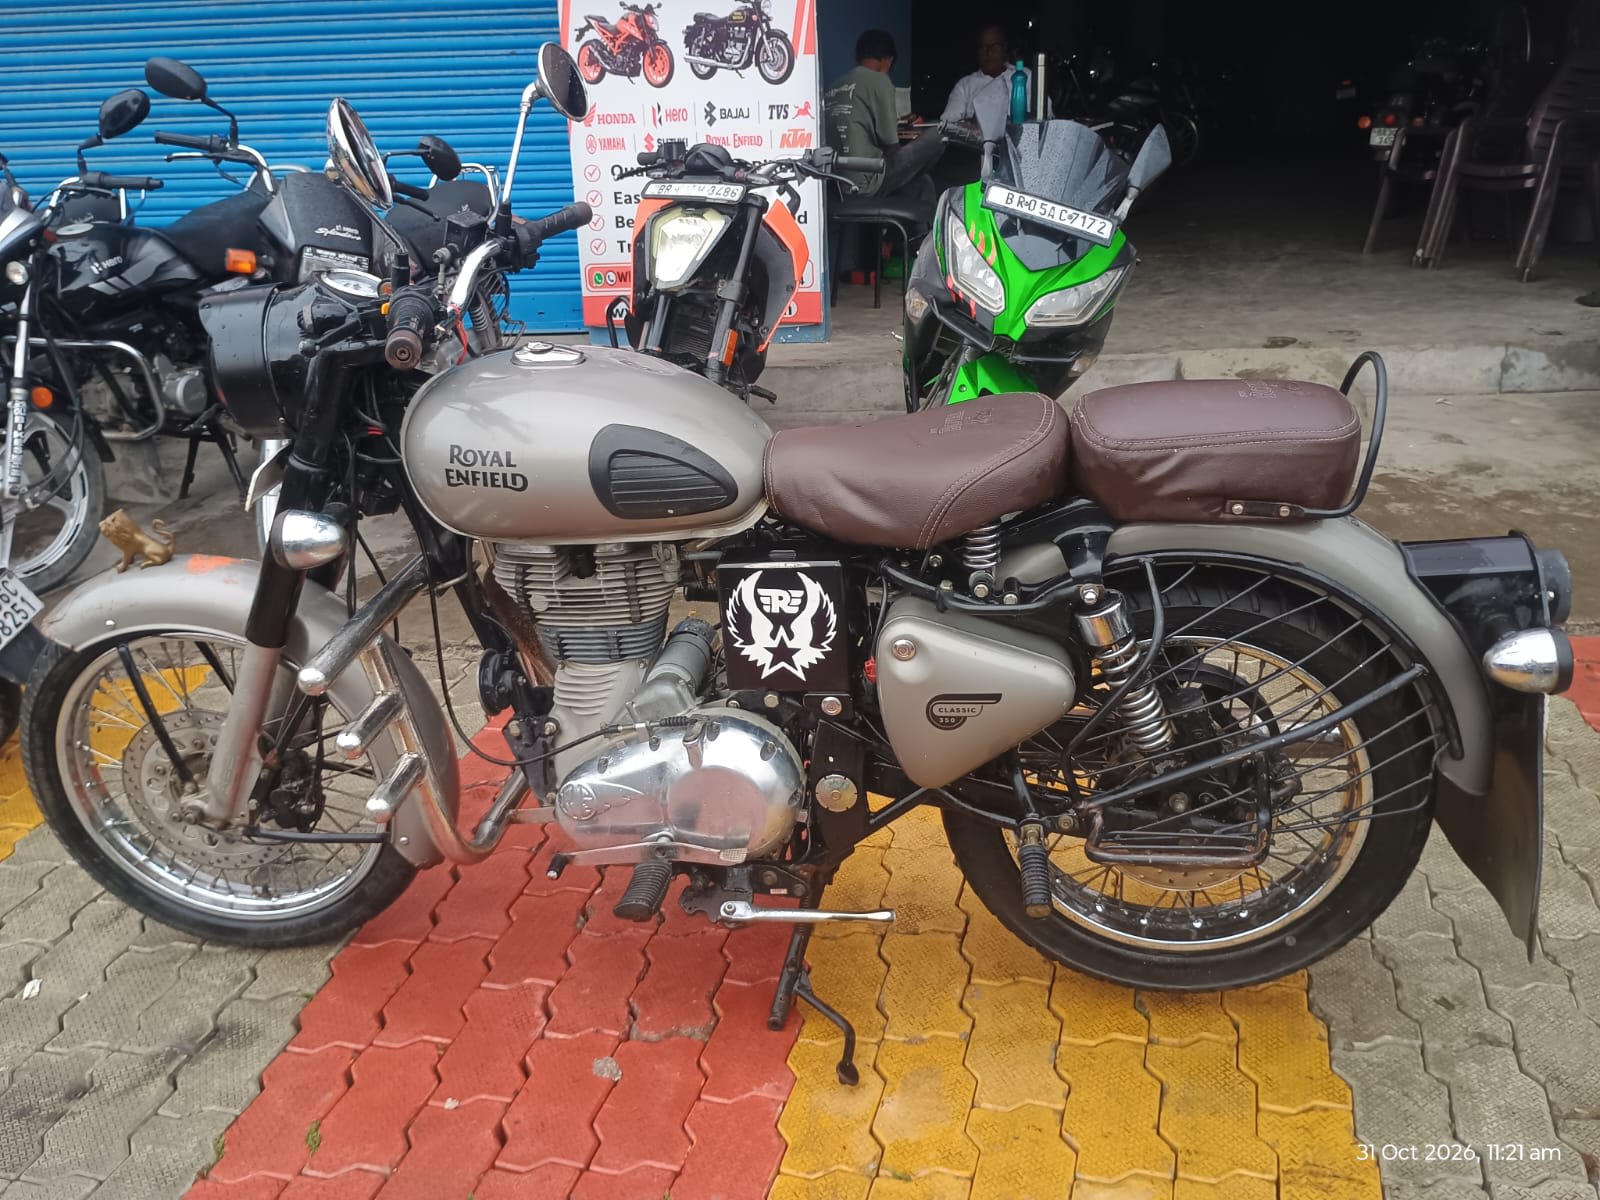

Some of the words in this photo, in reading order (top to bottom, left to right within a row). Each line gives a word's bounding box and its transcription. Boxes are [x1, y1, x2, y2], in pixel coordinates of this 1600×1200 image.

[597, 112, 636, 125] HONDA
[720, 107, 750, 119] BAJAJ
[768, 104, 789, 120] TVS
[598, 137, 626, 151] YAMAHA
[779, 129, 813, 148] KTM
[449, 444, 517, 468] ROYAL
[445, 468, 529, 492] ENFIELD
[0, 596, 37, 645] 8251
